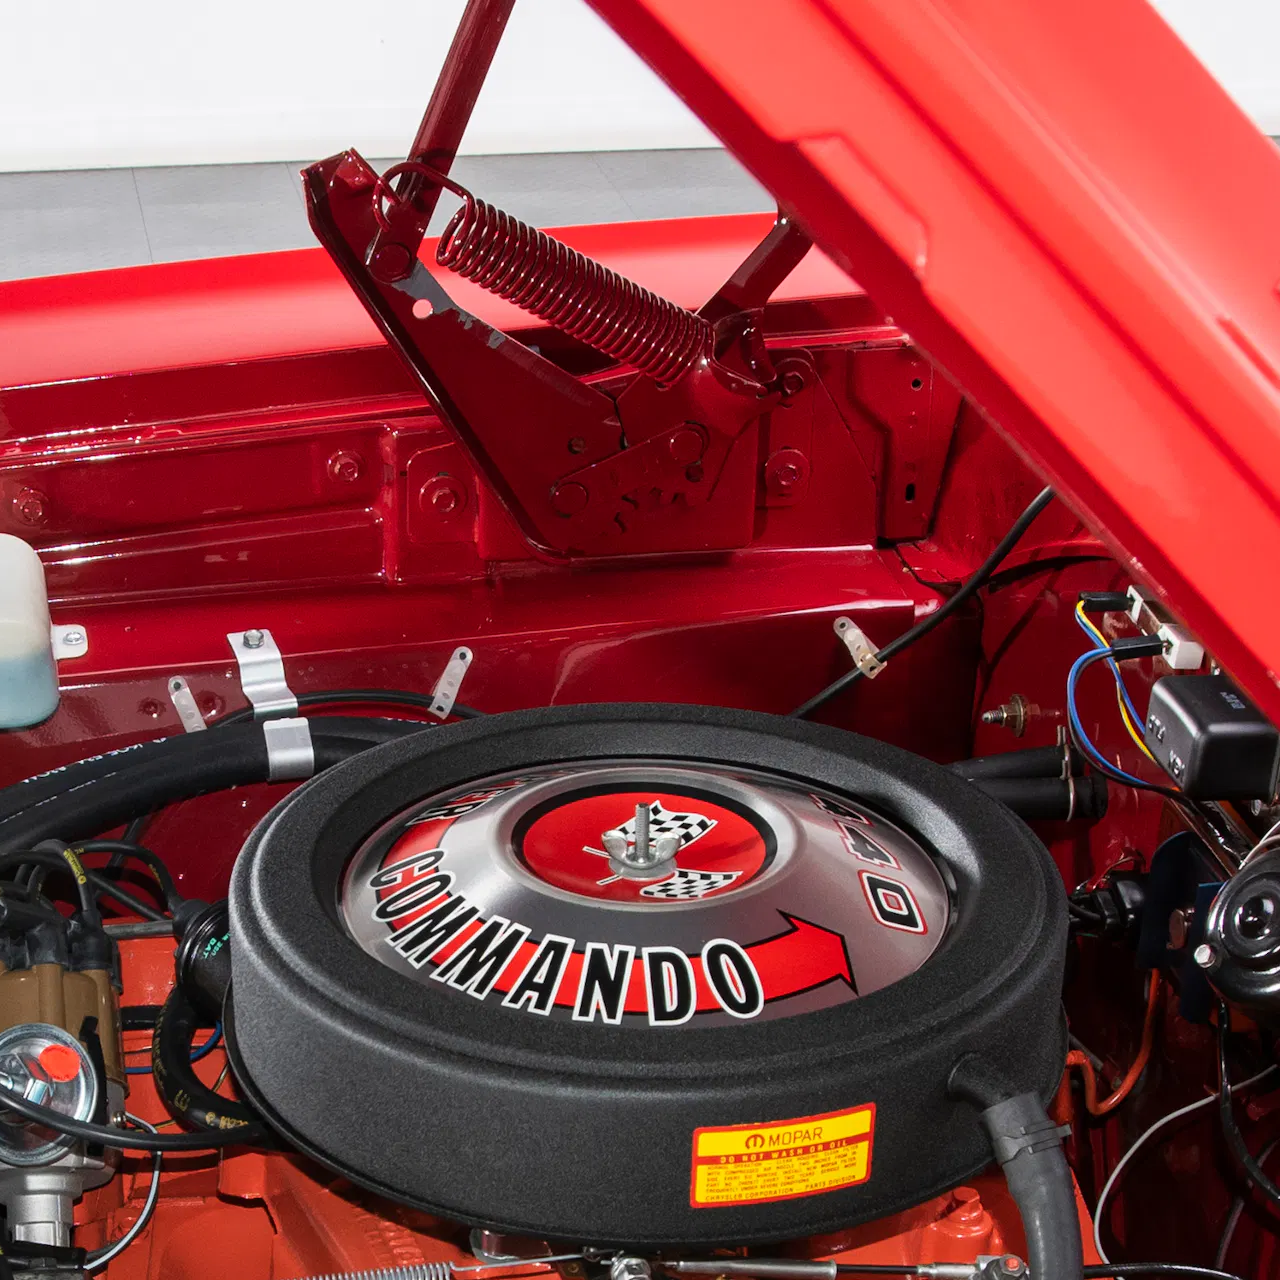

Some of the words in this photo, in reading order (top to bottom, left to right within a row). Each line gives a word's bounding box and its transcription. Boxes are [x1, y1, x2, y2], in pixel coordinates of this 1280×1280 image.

[810, 791, 928, 934] 440
[369, 849, 764, 1026] COMMANDO
[768, 1127, 823, 1148] MOPAR
[742, 1153, 764, 1162] NOT
[771, 1147, 803, 1159] WASH
[809, 1144, 824, 1153] OR
[829, 1140, 848, 1149] OIL
[705, 1193, 743, 1201] CHRYSLER
[745, 1188, 794, 1199] CORPORATION
[805, 1181, 826, 1189] PARTS
[828, 1175, 856, 1185] DIVISION
